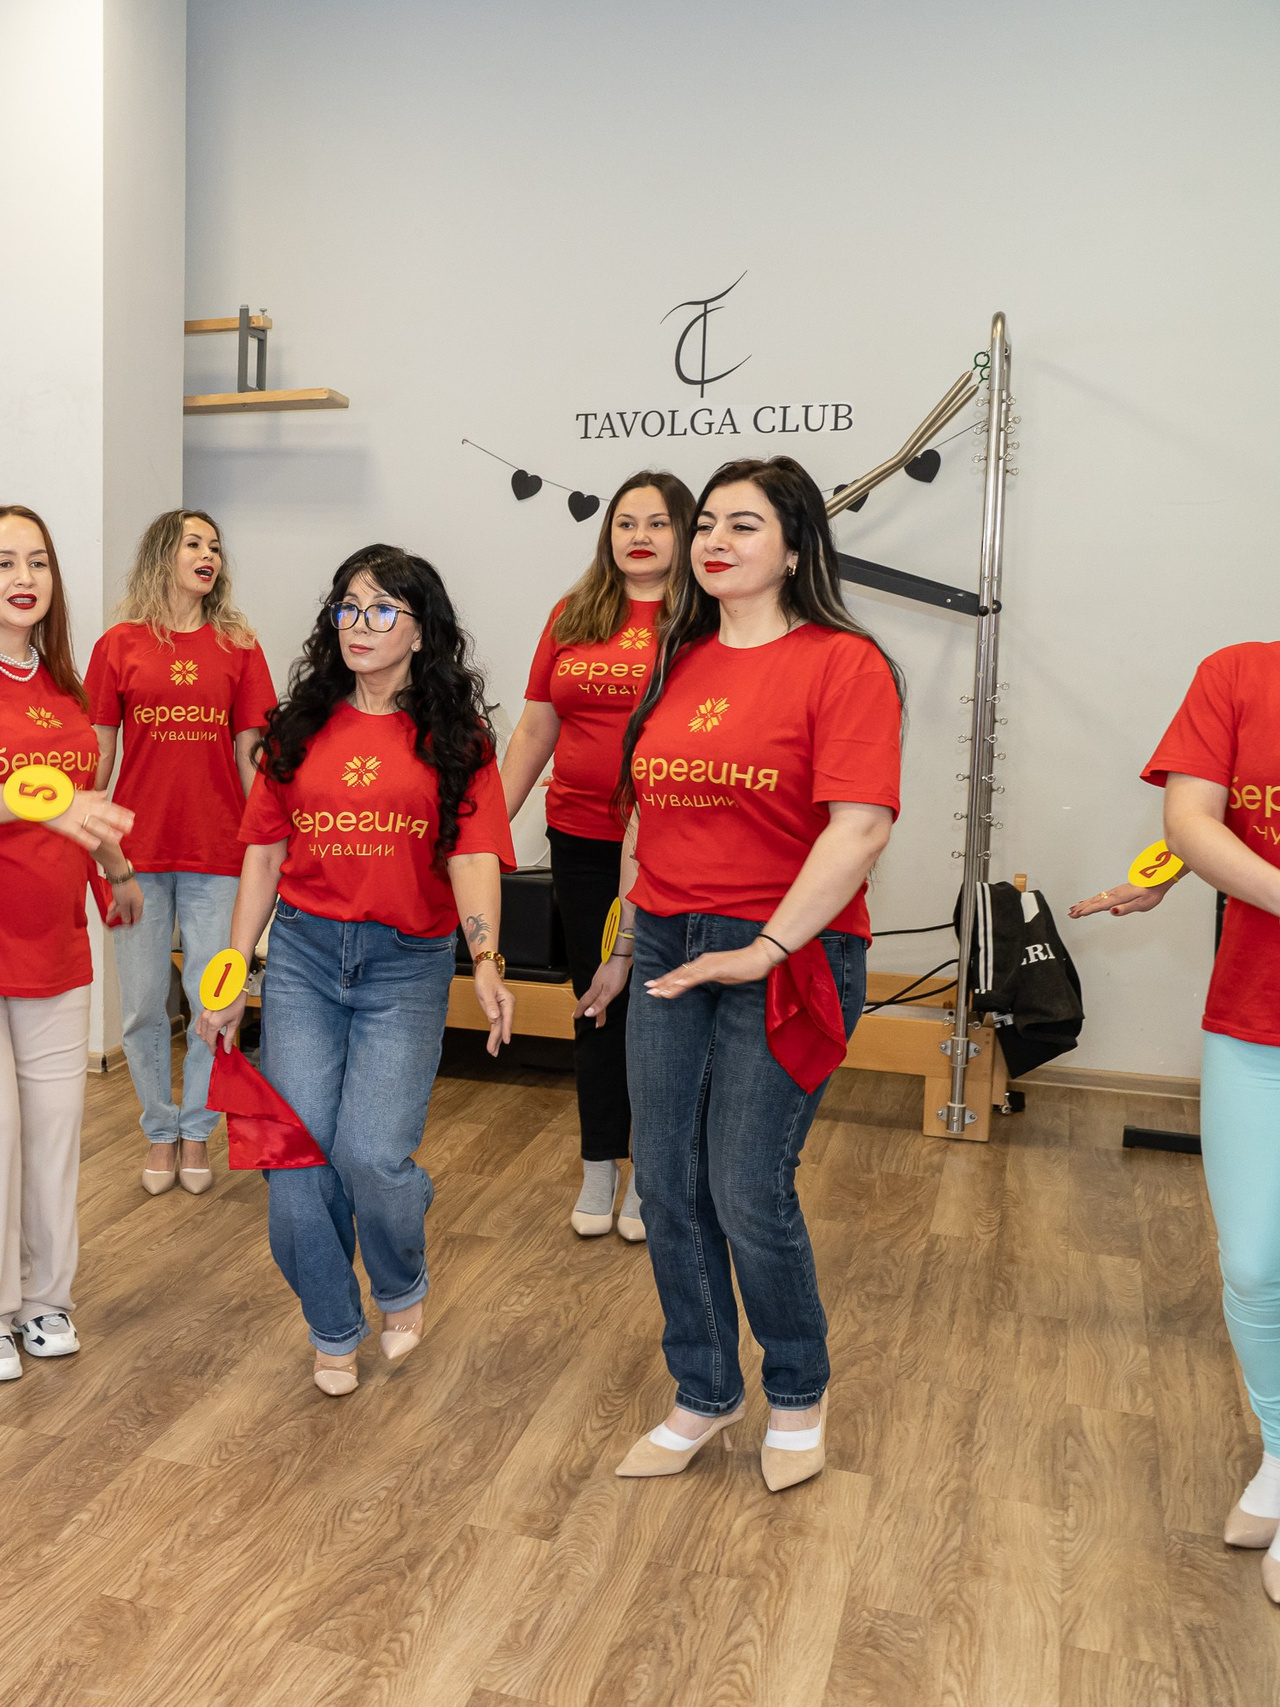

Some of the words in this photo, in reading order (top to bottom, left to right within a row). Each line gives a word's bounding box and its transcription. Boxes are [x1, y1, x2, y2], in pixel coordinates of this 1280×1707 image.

[575, 407, 741, 440] TAVOLGA
[753, 403, 854, 434] CLUB
[557, 657, 648, 680] берег
[150, 730, 218, 742] чувашии
[633, 756, 780, 792] ерегиня
[18, 781, 58, 802] 5
[309, 843, 395, 858] чувашии
[1138, 850, 1172, 879] 2
[213, 962, 233, 998] 1
